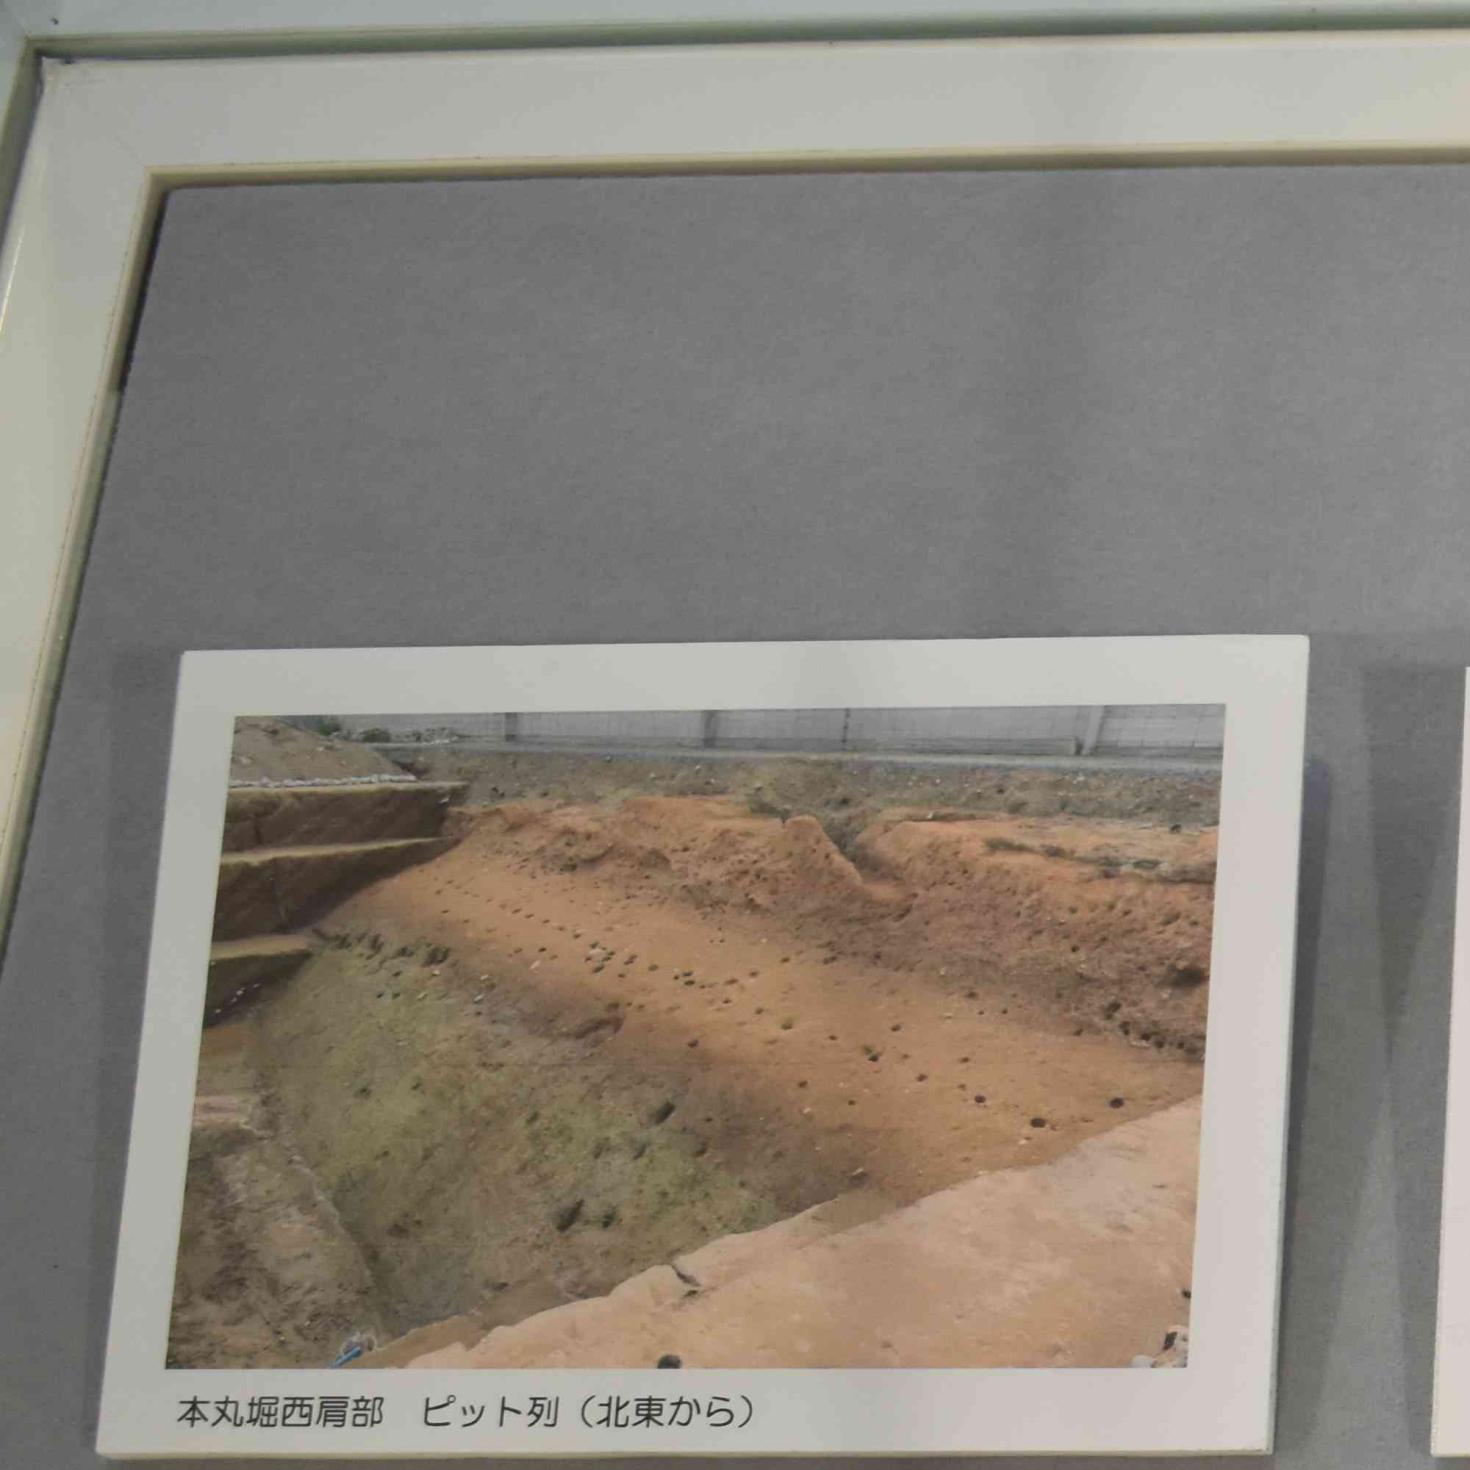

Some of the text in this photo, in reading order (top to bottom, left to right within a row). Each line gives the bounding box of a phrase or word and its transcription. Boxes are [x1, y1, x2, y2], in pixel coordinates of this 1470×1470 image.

[176, 1394, 753, 1428] 本丸堀西肩部 ピット列（北東から）
